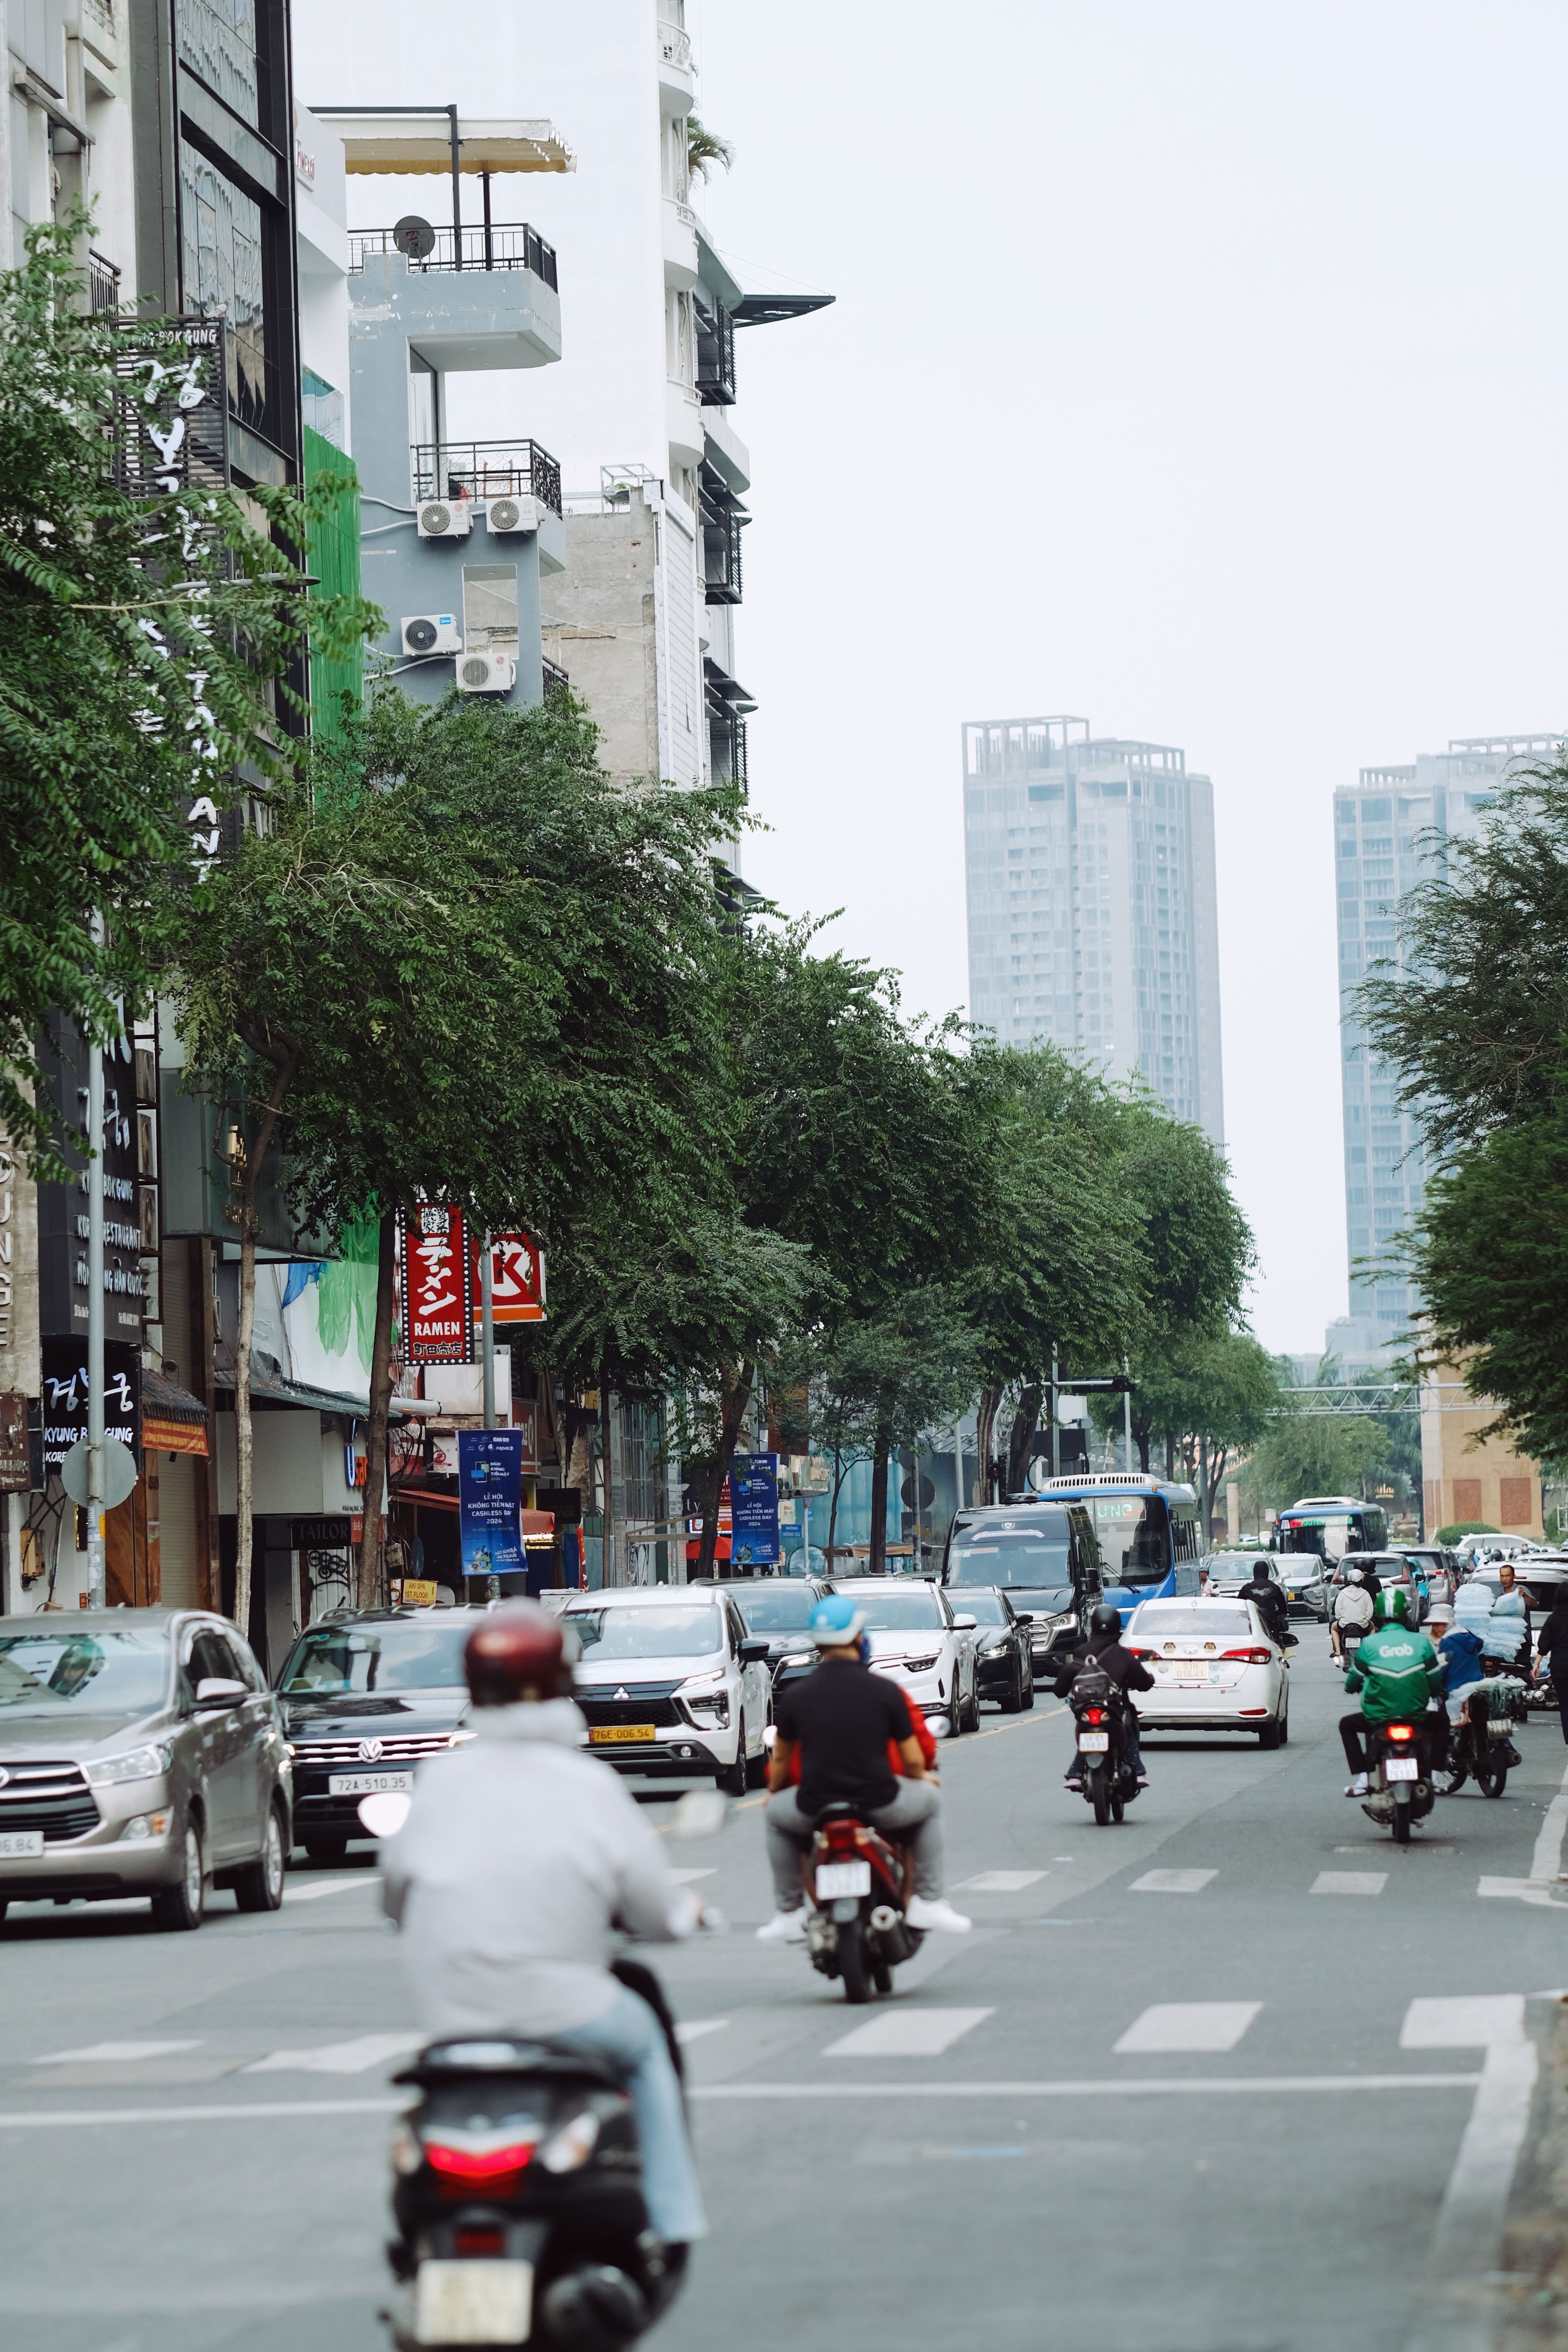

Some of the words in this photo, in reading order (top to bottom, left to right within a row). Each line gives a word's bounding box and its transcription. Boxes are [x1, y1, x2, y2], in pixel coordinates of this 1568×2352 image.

[116, 1178, 133, 1203] GUNG
[103, 1221, 141, 1251] RESTAURANT
[414, 1321, 460, 1336] RAMEN
[413, 1341, 462, 1357] 町田商店
[44, 1427, 78, 1443] KYUNG
[298, 1523, 348, 1540] TAILOR
[1379, 1643, 1413, 1657] Grab
[594, 1728, 649, 1740] 76E-006.54
[338, 1777, 406, 1790] 72A-510.35
